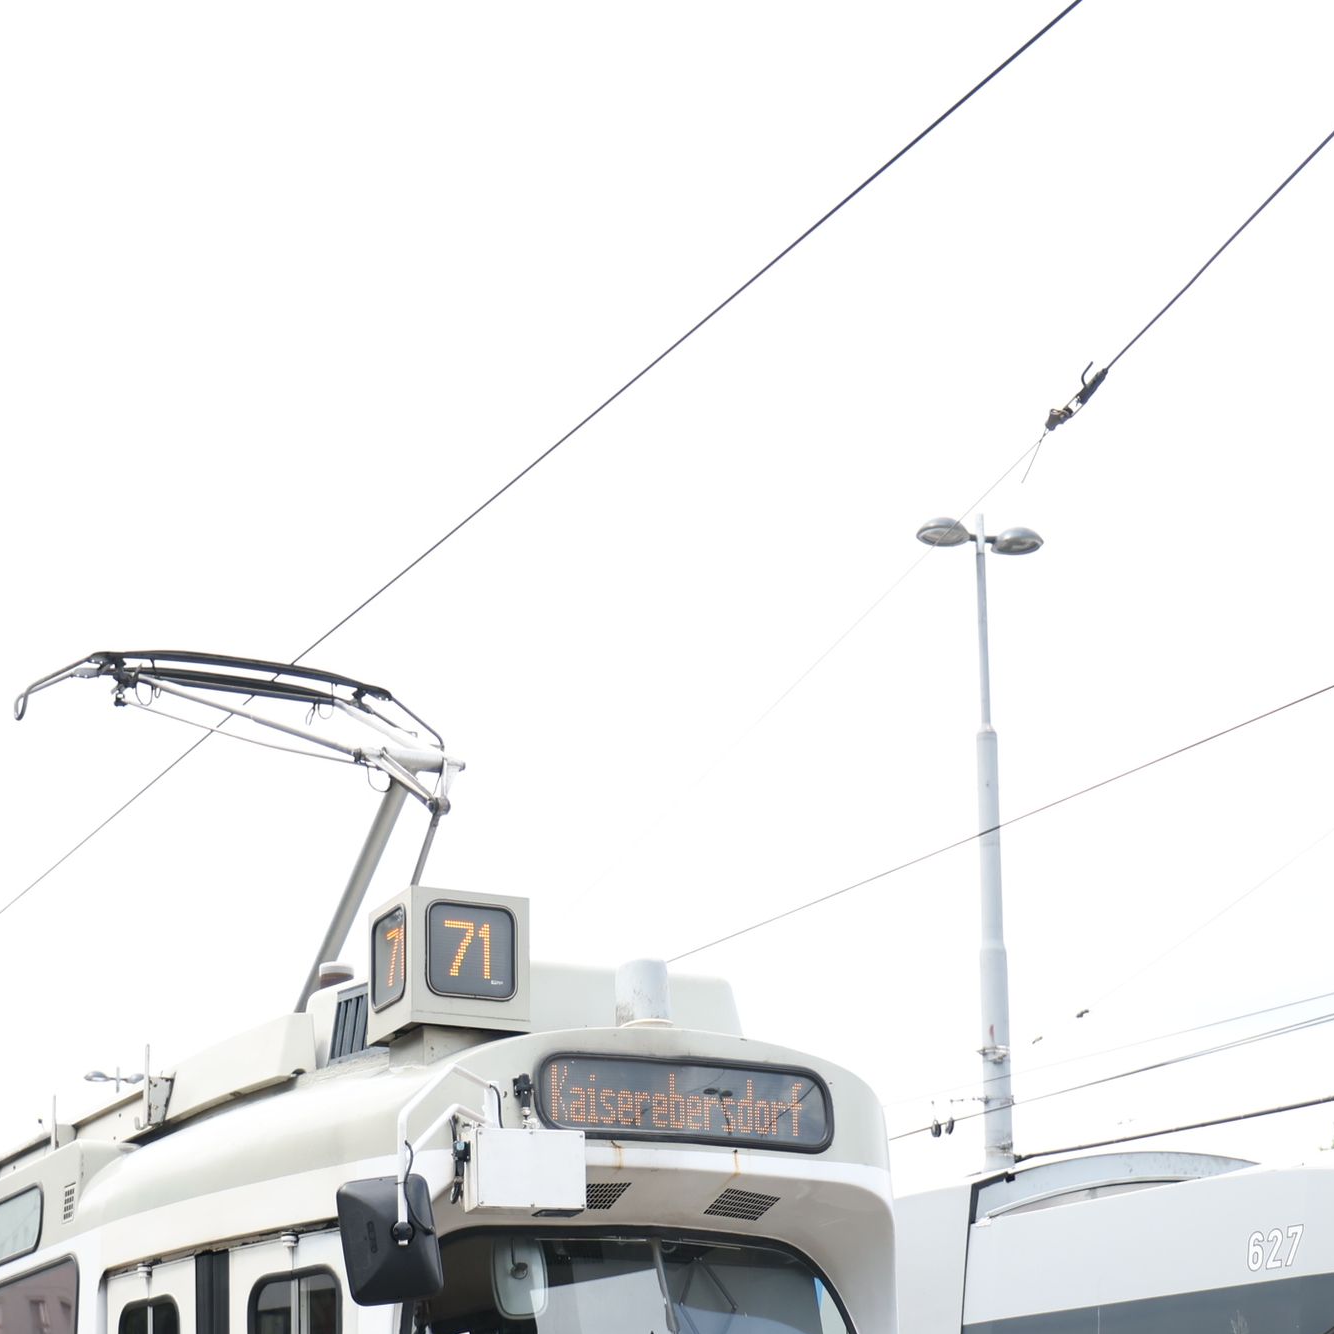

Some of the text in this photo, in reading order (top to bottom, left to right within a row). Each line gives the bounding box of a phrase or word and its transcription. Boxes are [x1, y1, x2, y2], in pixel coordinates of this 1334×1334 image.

[443, 920, 491, 979] 71
[551, 1064, 803, 1137] Kaiserebersdorf
[1247, 1224, 1304, 1272] 627
